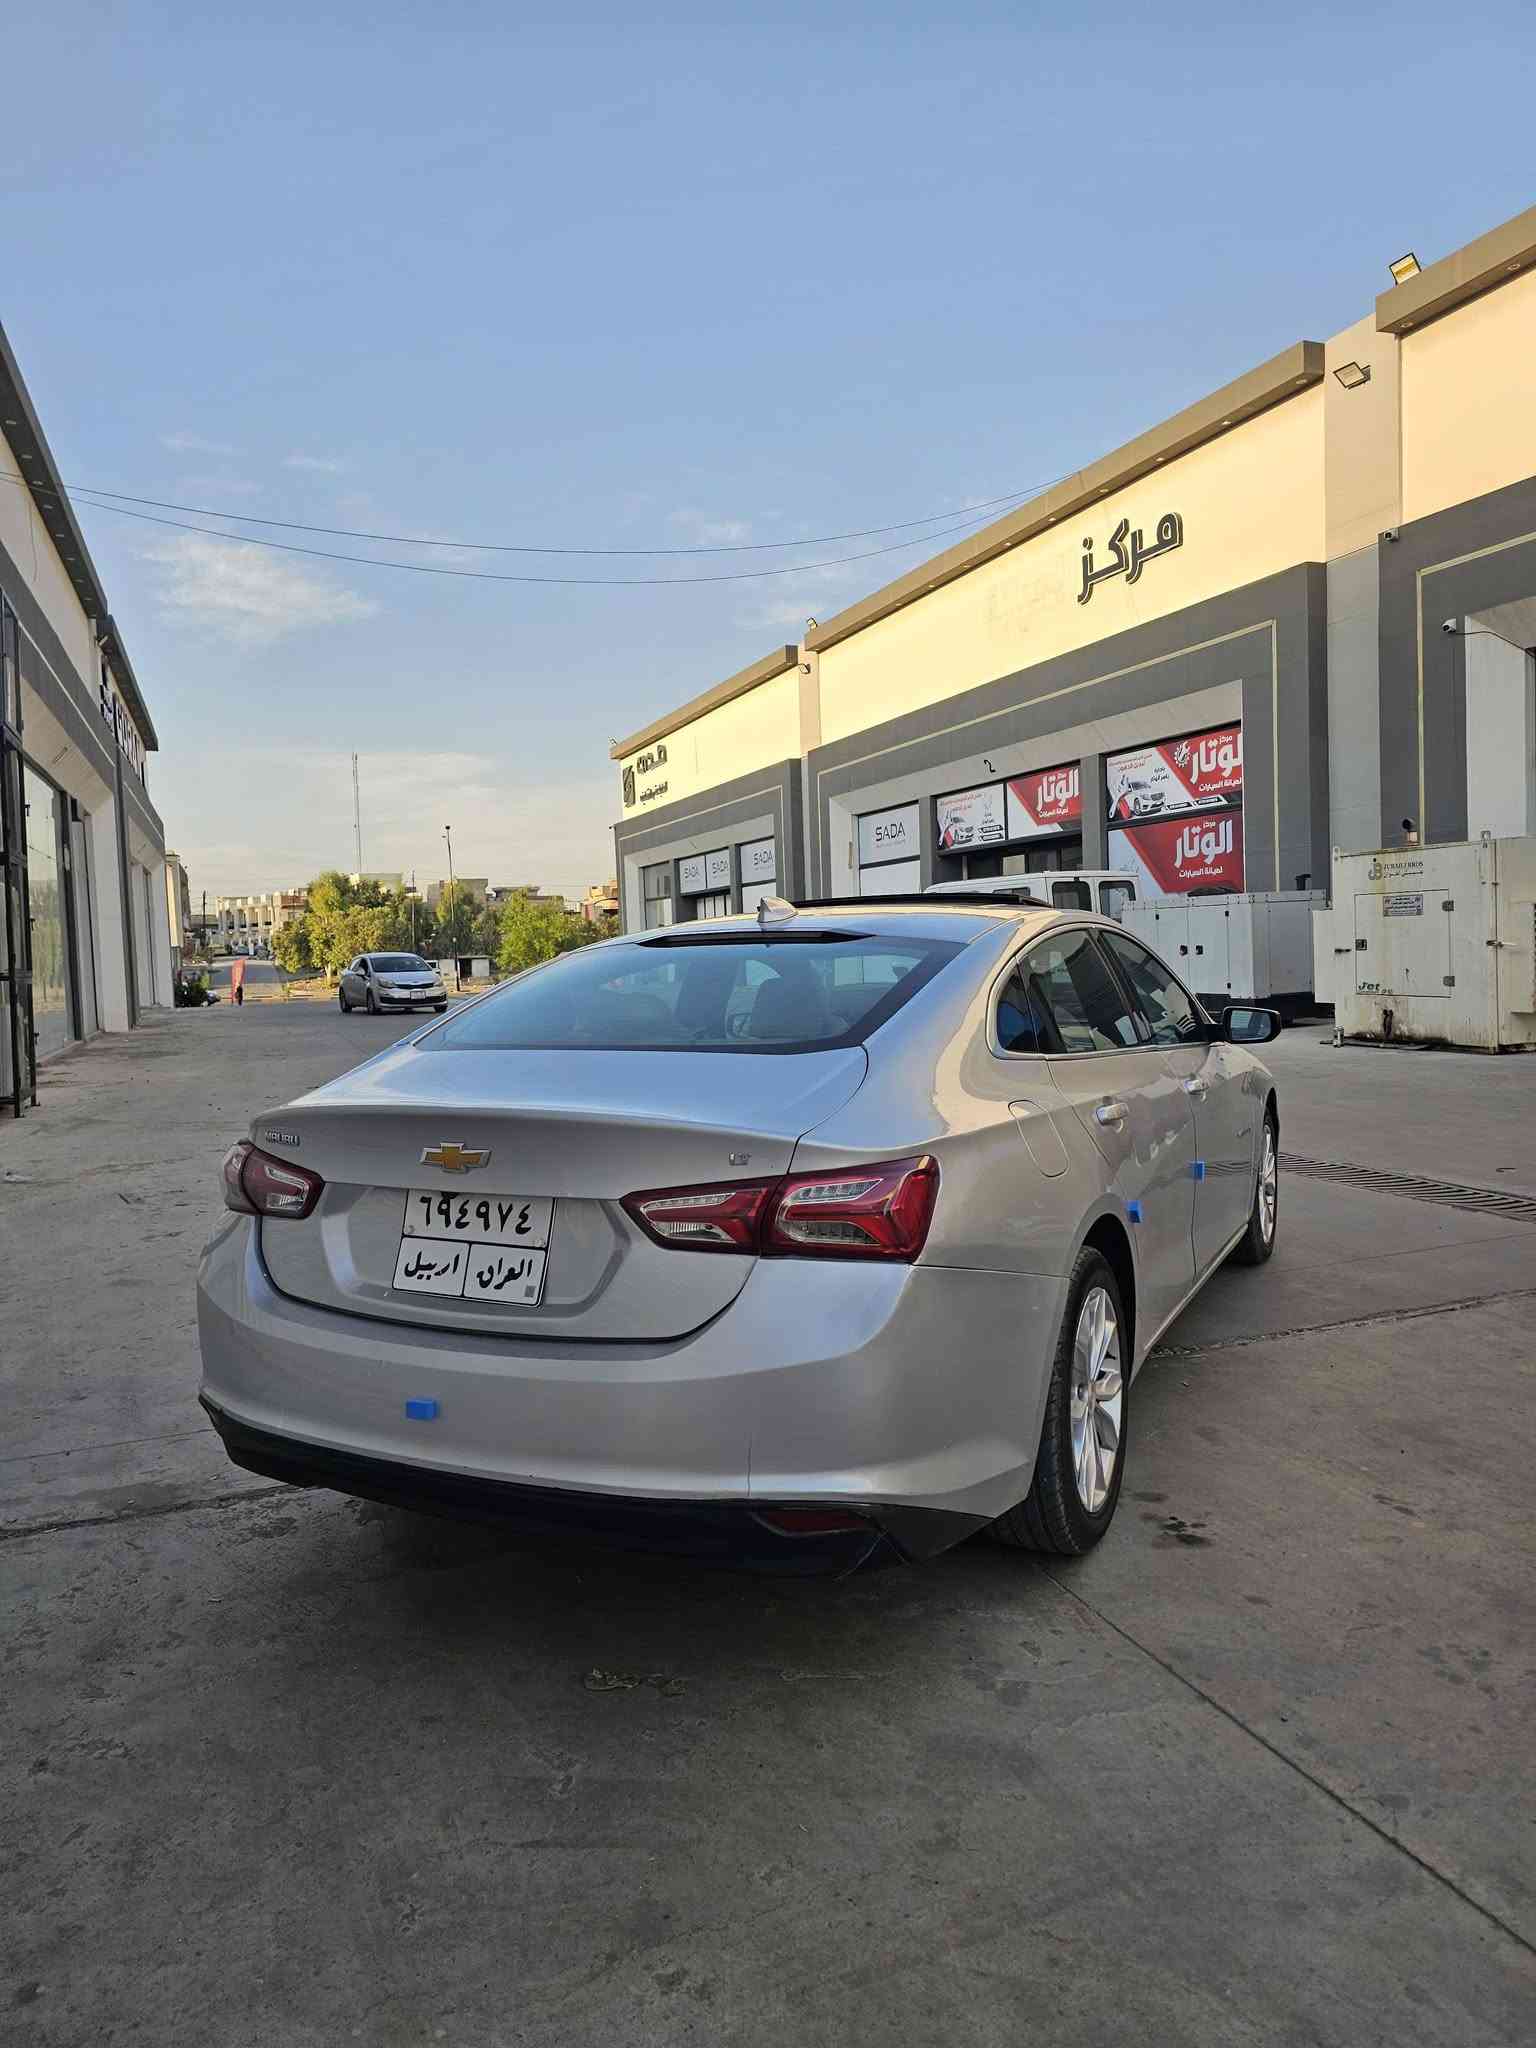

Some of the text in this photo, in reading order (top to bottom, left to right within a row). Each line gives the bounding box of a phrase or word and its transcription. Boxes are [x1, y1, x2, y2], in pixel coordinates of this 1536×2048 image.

[1077, 512, 1184, 605] مركز
[1189, 732, 1243, 785] لوتار
[875, 821, 906, 842] SADA
[1173, 819, 1233, 869] الوتار
[752, 848, 775, 866] SADA
[419, 1195, 532, 1235] ٦٩٤٩٧٤
[403, 1250, 460, 1281] اربيل
